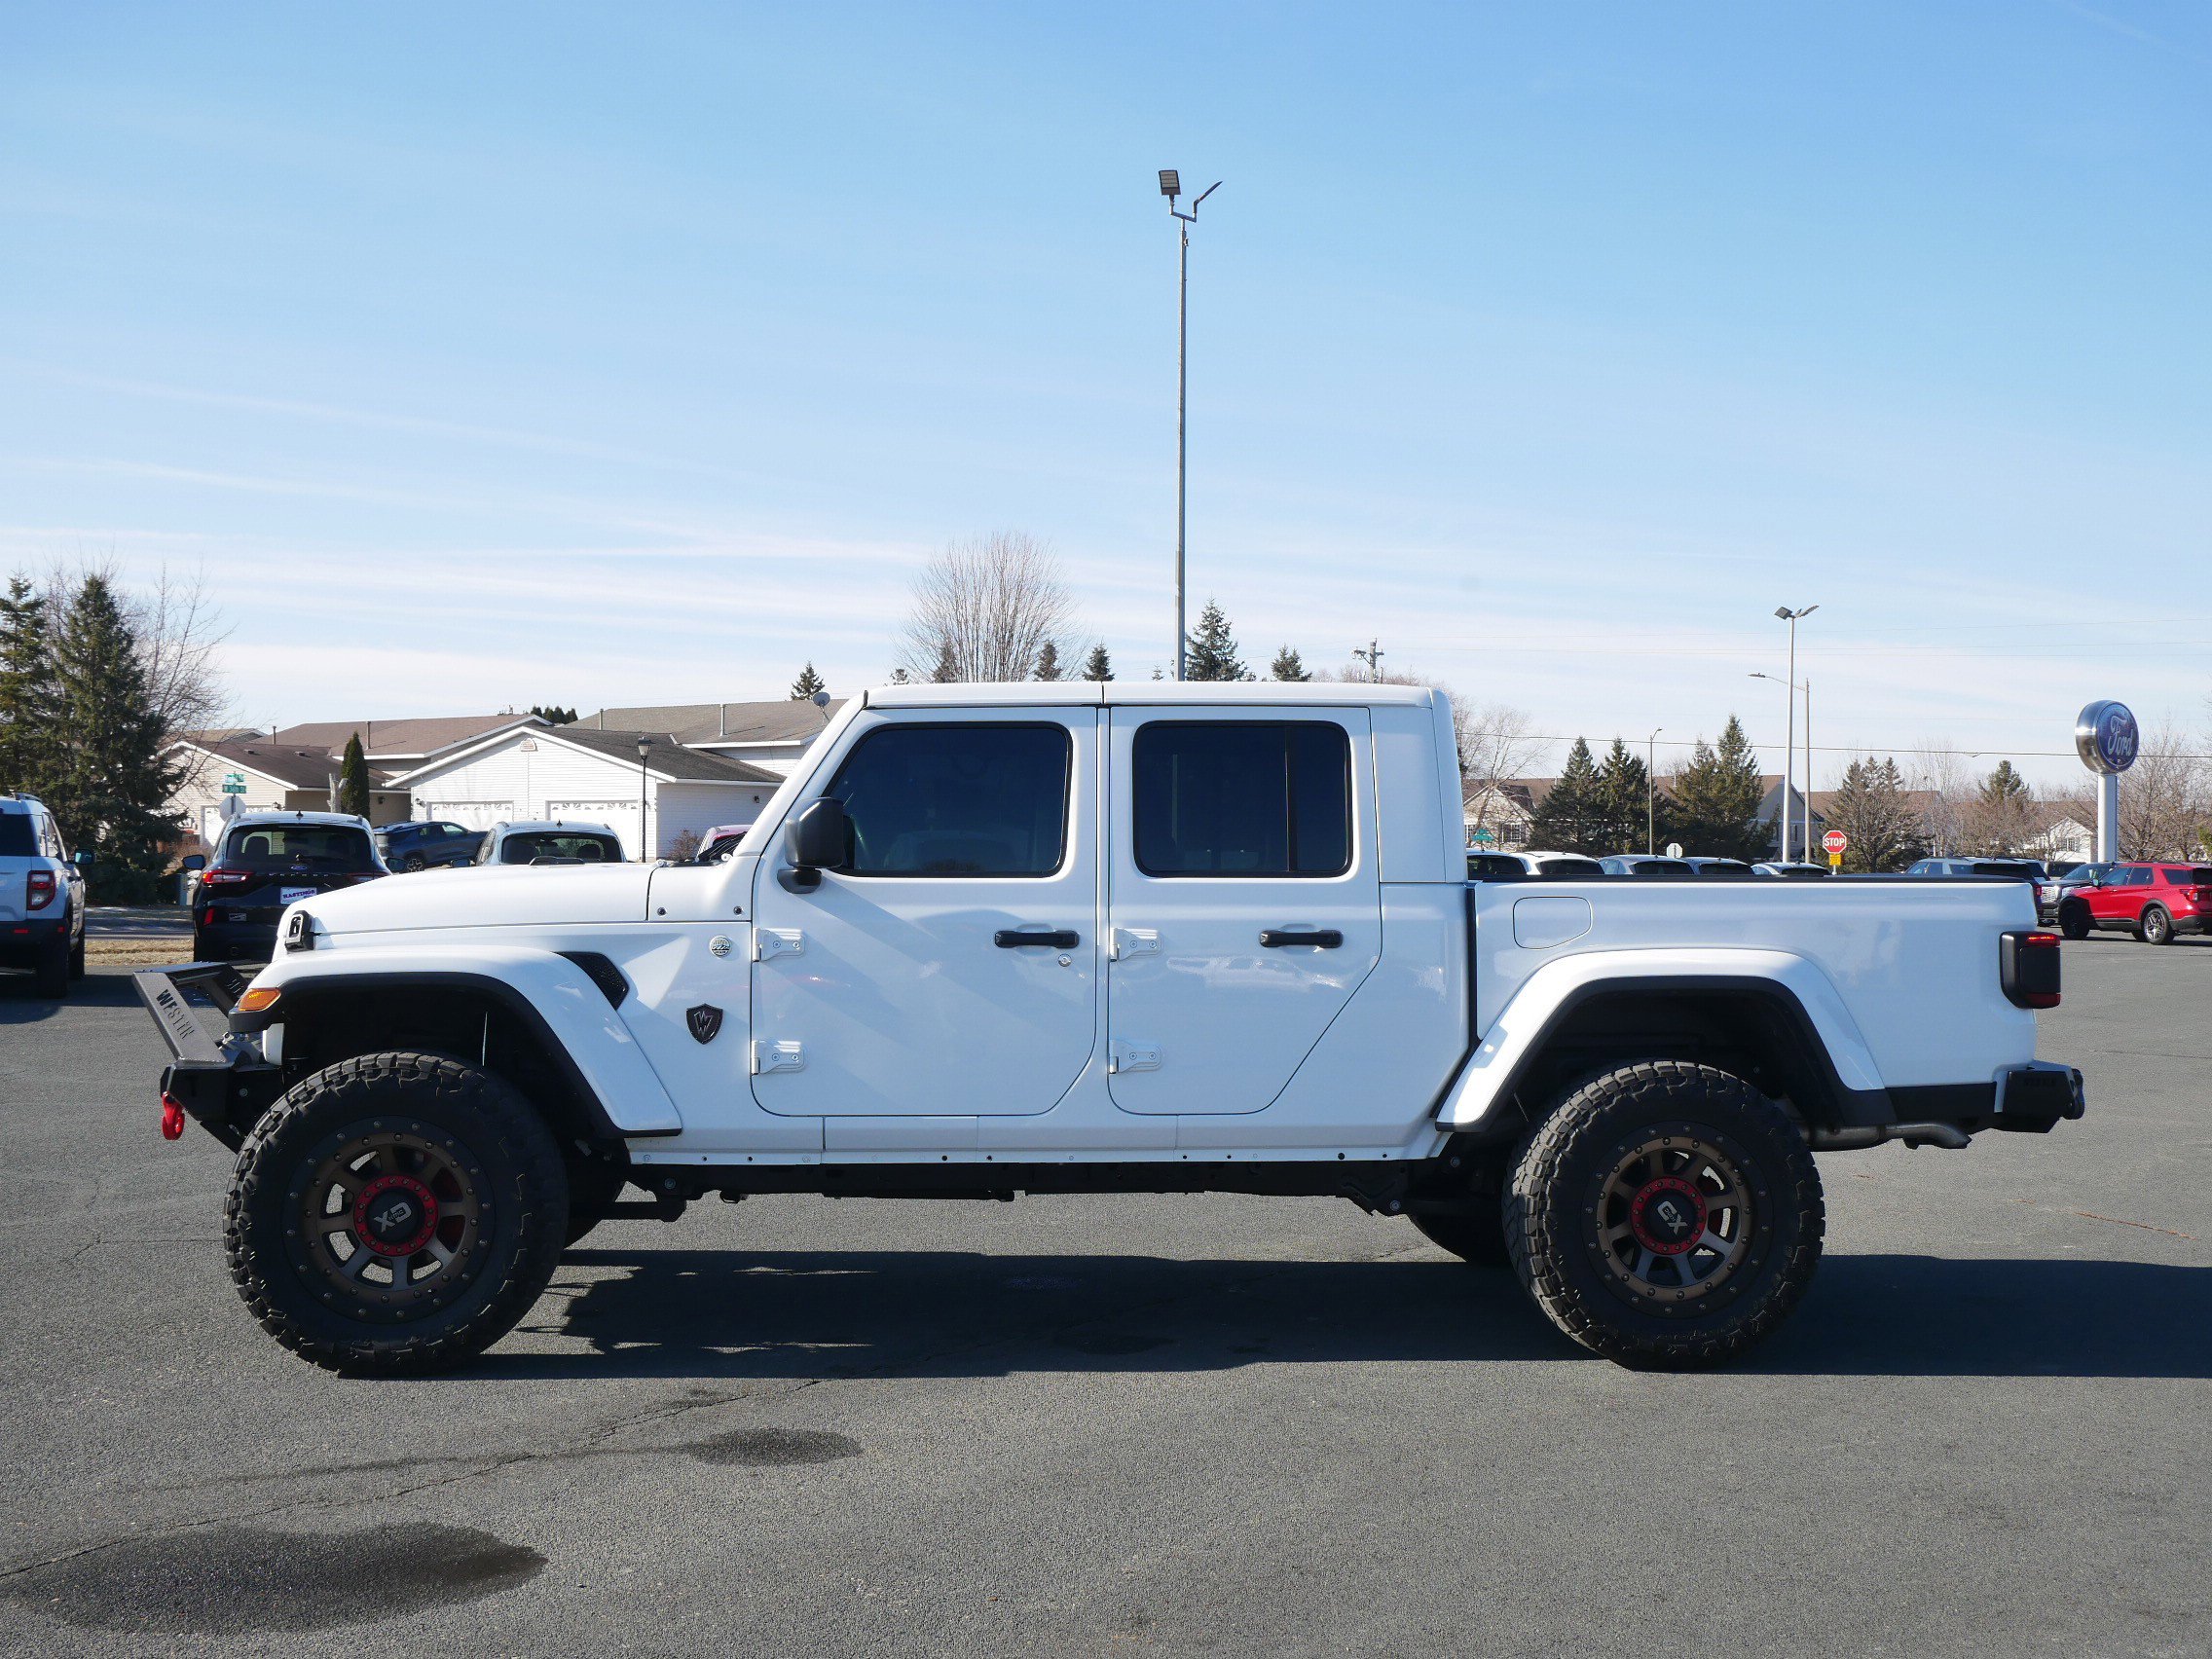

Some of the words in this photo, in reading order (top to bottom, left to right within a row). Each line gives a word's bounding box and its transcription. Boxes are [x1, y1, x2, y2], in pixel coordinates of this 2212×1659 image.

[2108, 716, 2134, 756] Ford
[1824, 837, 1845, 847] STOP
[374, 1202, 412, 1233] XD
